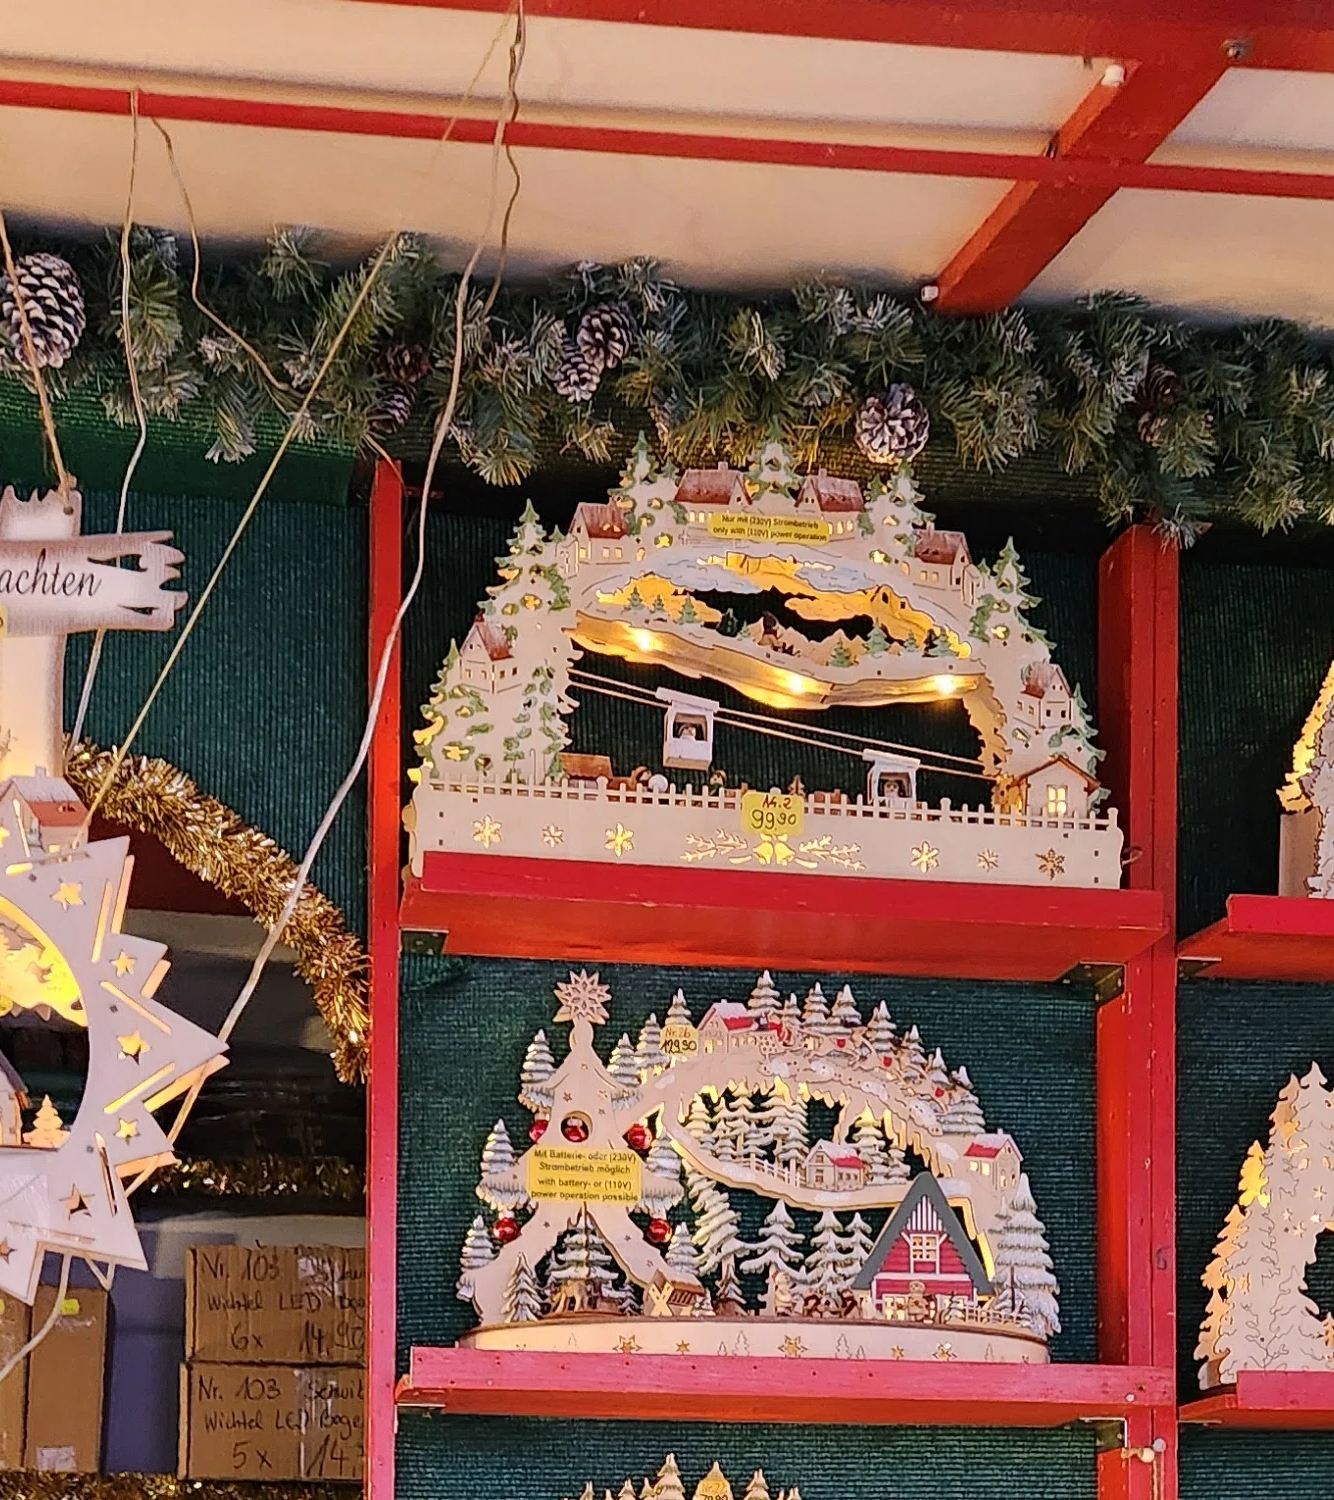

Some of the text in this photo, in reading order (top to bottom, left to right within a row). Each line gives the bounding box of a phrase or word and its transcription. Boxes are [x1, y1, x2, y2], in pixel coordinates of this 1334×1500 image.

[752, 810, 796, 831] 99.90
[279, 1291, 322, 1313] LED
[235, 1377, 281, 1401] 103
